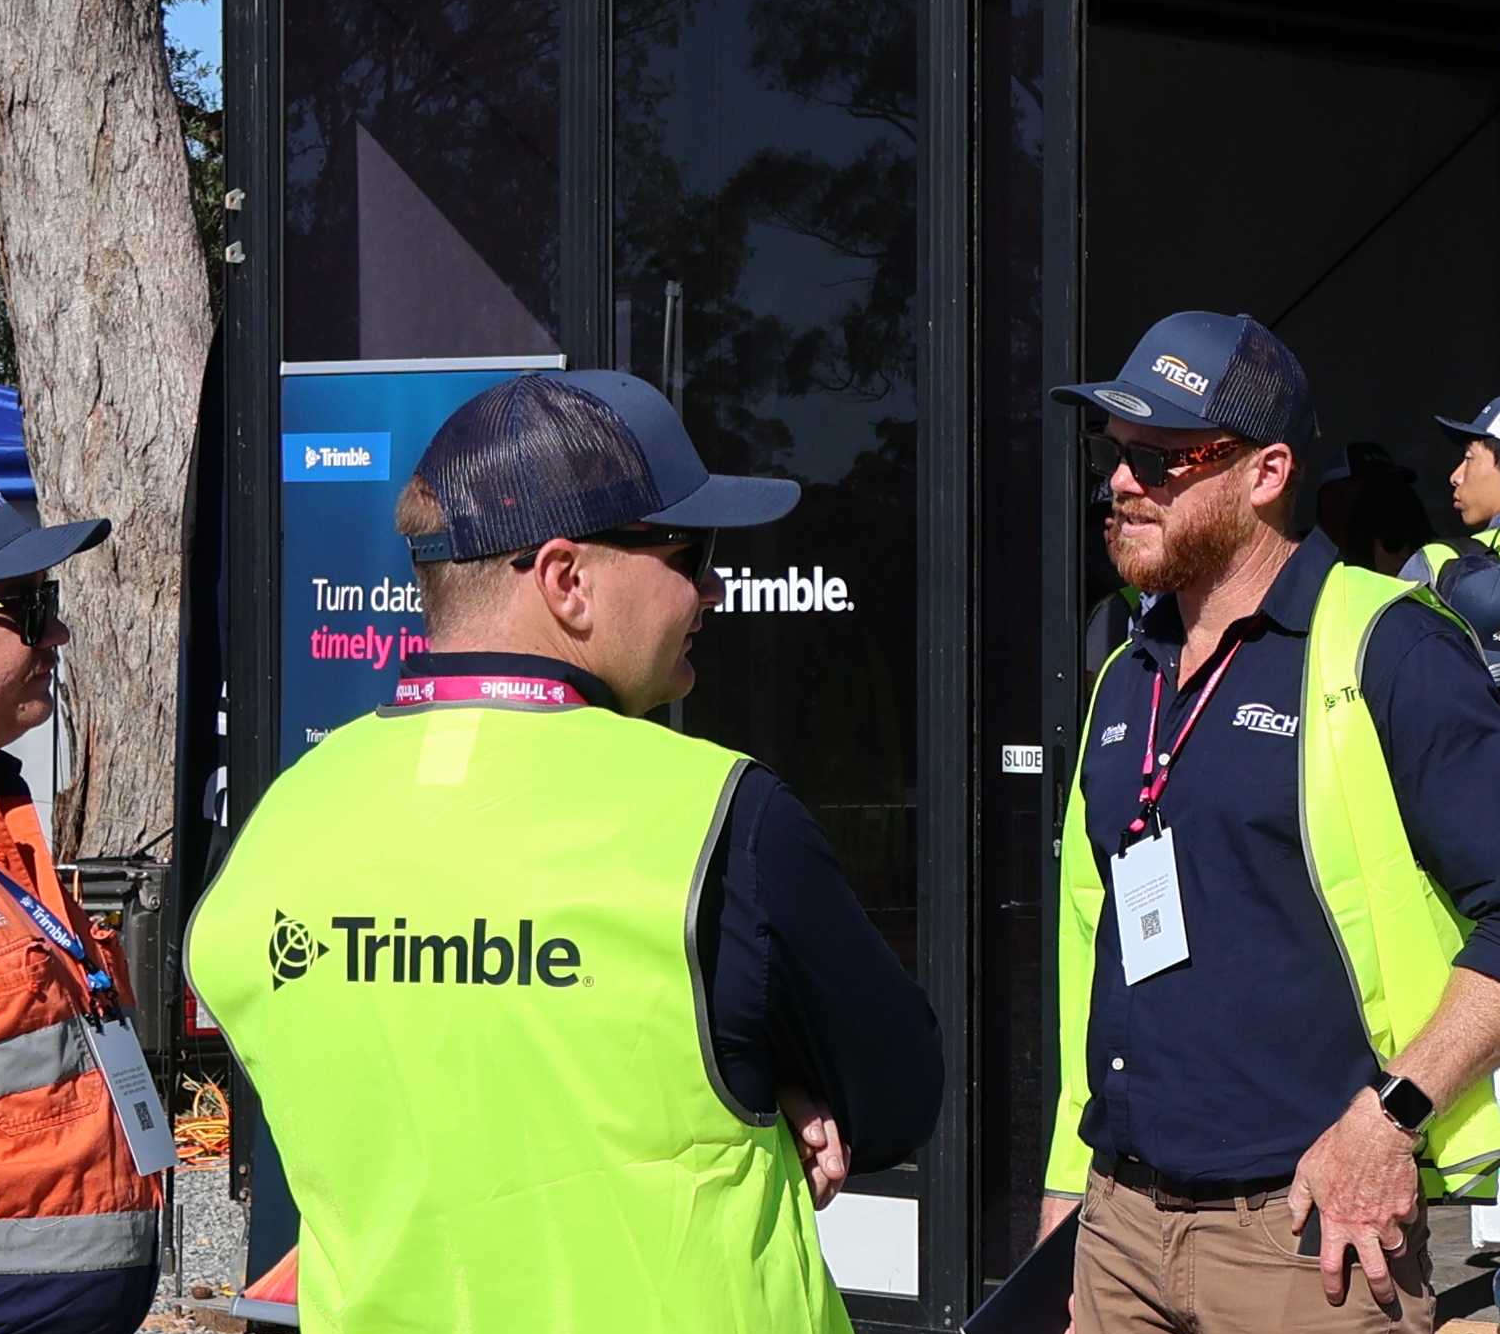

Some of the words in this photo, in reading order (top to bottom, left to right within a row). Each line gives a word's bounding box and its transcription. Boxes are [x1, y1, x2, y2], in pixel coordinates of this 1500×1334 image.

[1152, 355, 1209, 393] SITECH
[312, 578, 363, 612] Turn
[310, 625, 394, 670] timely
[1232, 708, 1299, 734] SITECH
[1004, 750, 1042, 767] SLIDE
[31, 903, 73, 949] Trimble
